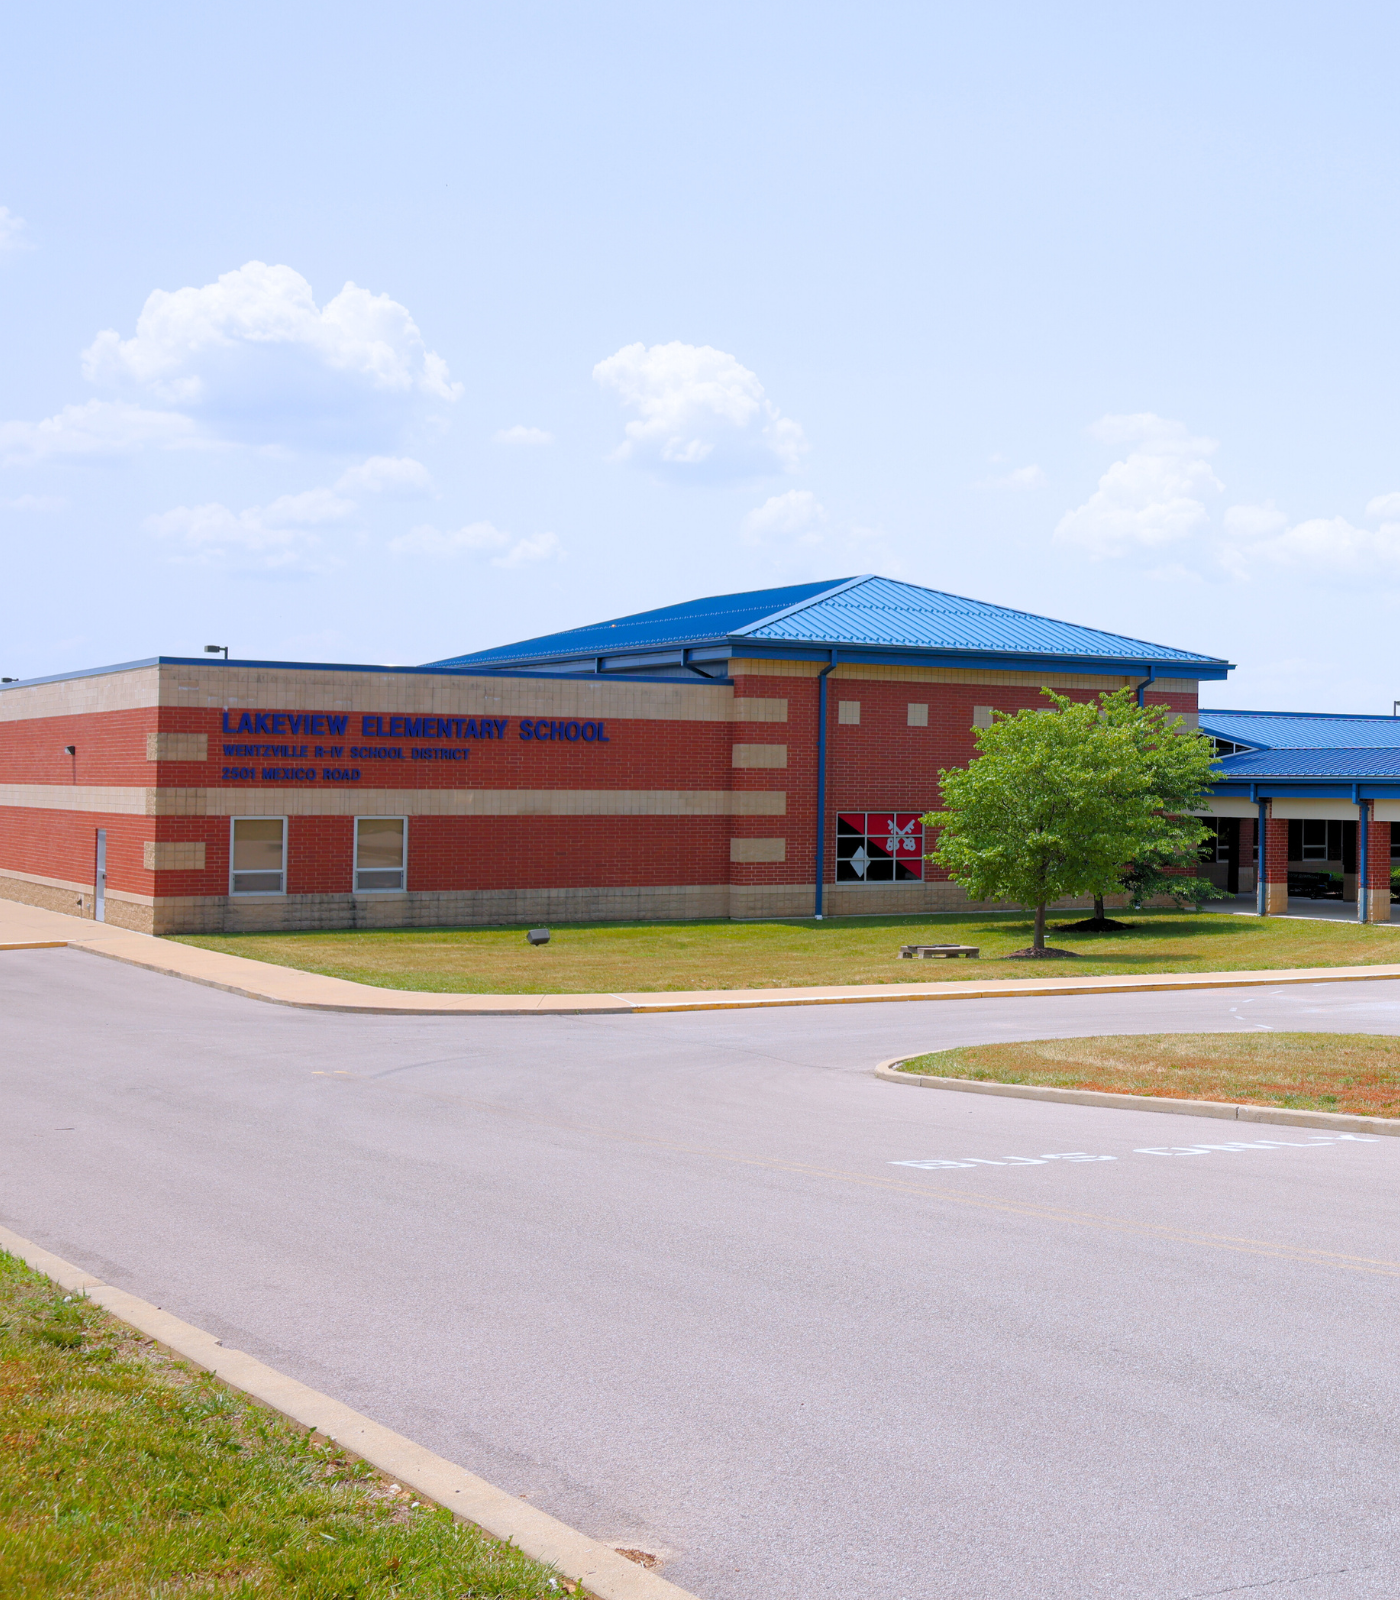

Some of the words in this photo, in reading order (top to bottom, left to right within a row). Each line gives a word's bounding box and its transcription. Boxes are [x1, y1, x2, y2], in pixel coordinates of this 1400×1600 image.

[222, 712, 349, 735] LAKEVIEW
[362, 715, 508, 739] ELEMENTARY
[519, 719, 610, 742] SCHOOL
[223, 744, 309, 758] WENTZVILLE
[315, 746, 344, 758] R-IV
[350, 746, 406, 760] SCHOOL
[411, 747, 470, 760] DISTRICT
[222, 767, 256, 780] 2501
[262, 768, 317, 781] MEXICO
[322, 768, 361, 781] ROAD
[886, 1152, 1118, 1170] BUS
[1132, 1134, 1381, 1156] ONLY
